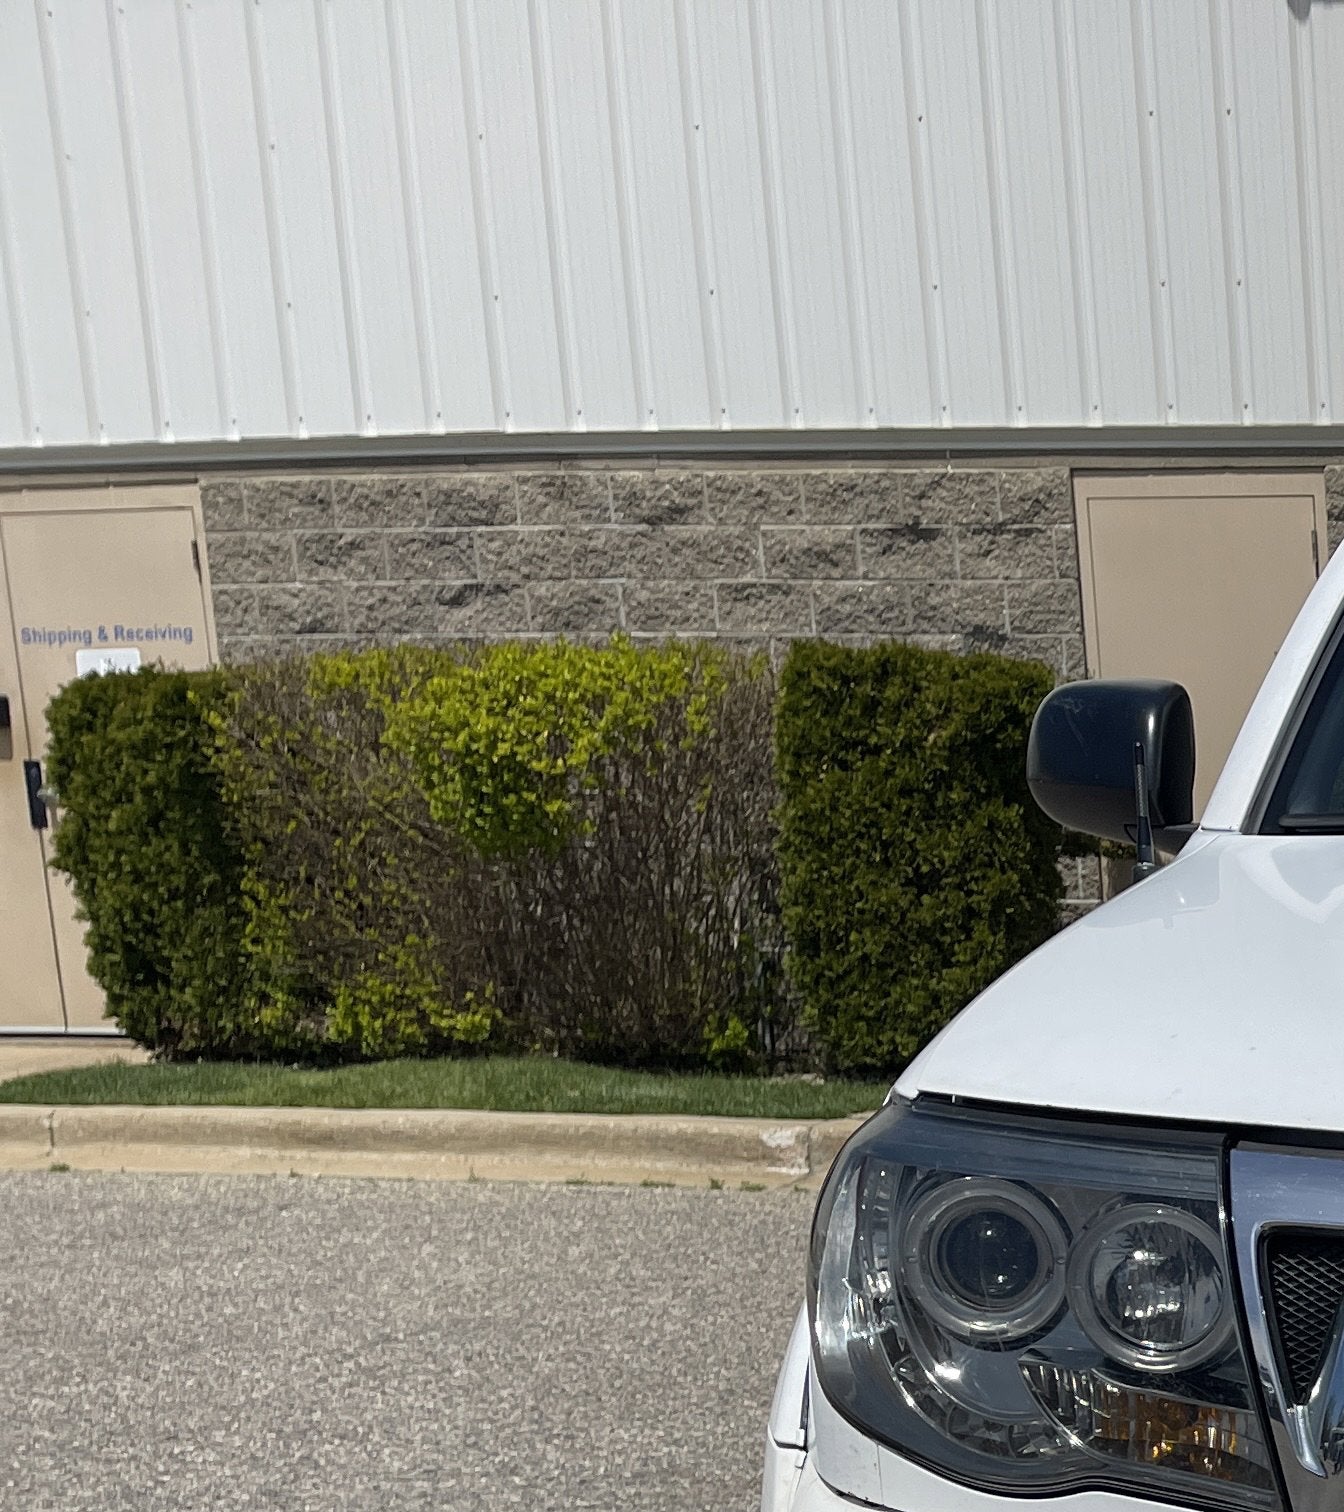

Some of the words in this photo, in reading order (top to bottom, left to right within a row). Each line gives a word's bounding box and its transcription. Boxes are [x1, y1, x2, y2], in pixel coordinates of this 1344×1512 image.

[21, 626, 92, 646] Shipping
[98, 625, 108, 642] &
[114, 623, 193, 644] Receiving
